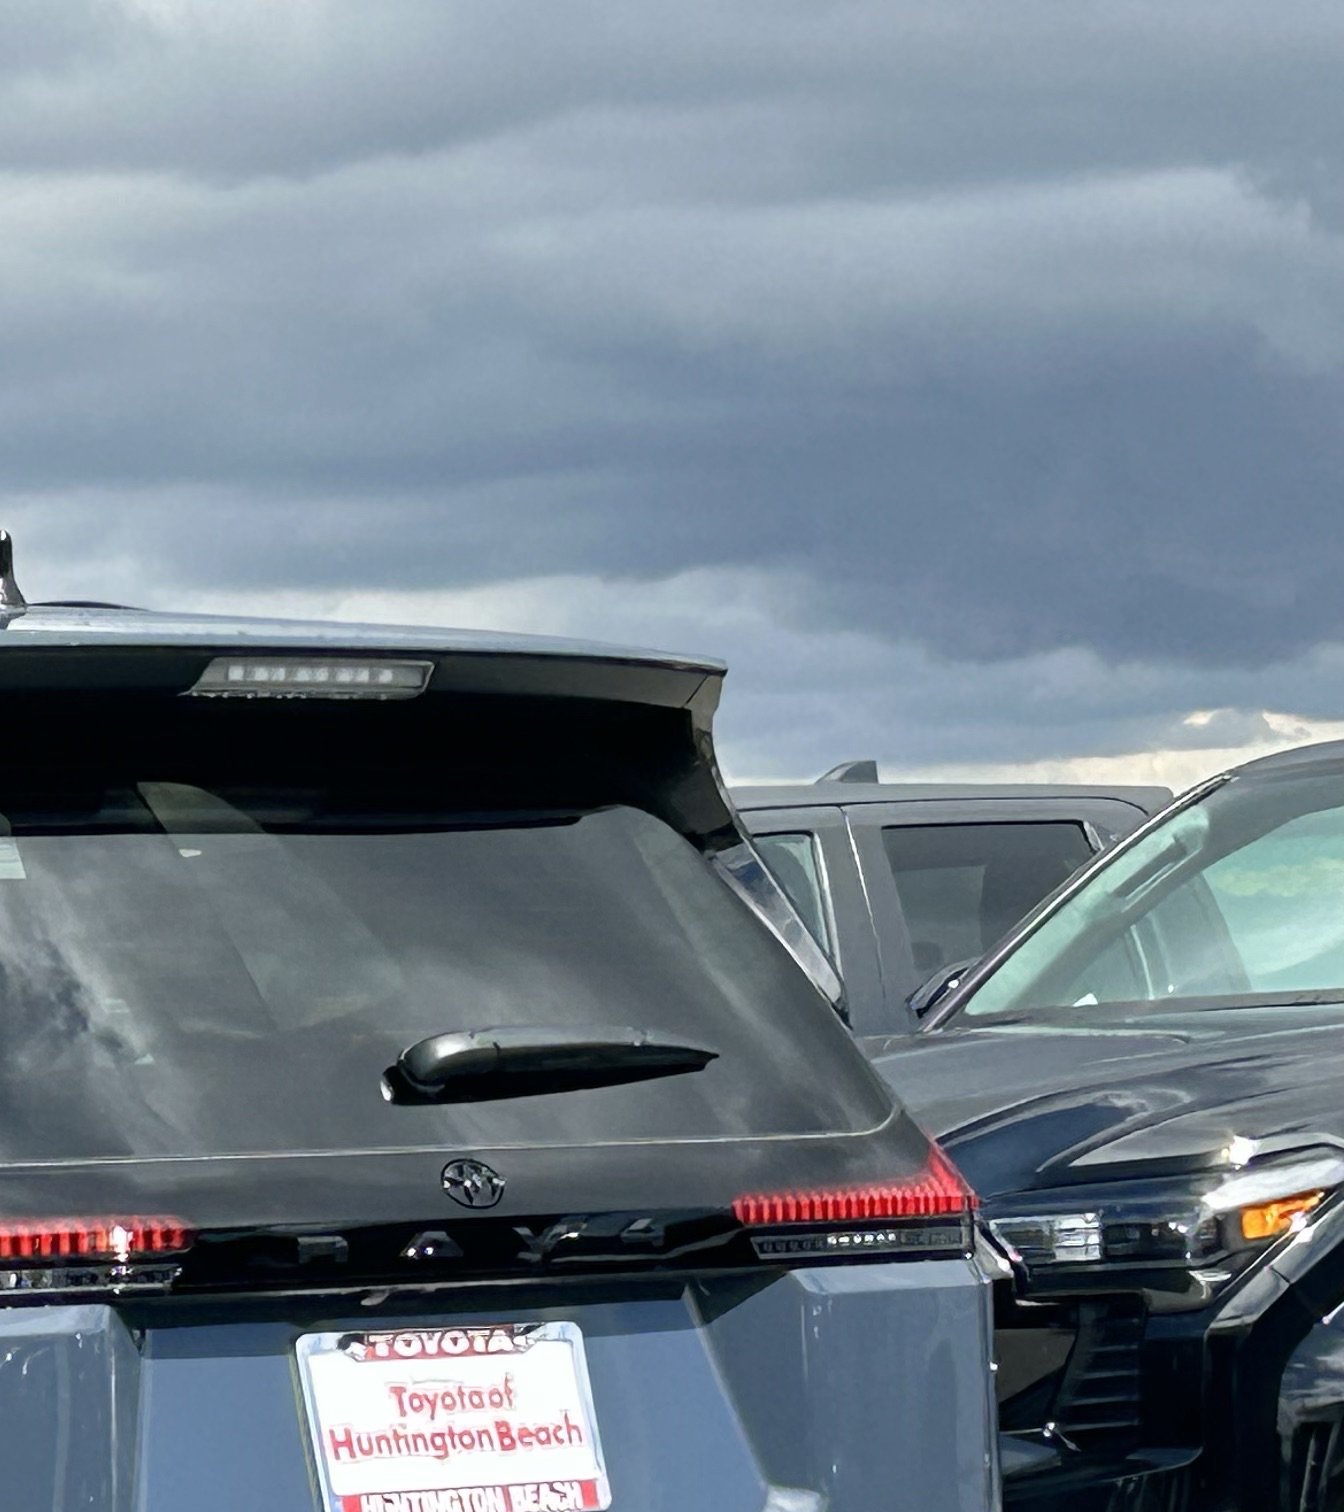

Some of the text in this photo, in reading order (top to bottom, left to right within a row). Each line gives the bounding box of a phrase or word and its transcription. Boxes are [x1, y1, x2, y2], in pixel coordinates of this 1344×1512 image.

[368, 1329, 514, 1357] TOYOTA
[388, 1373, 514, 1421] Toyota of
[328, 1410, 583, 1461] Huntington Beach
